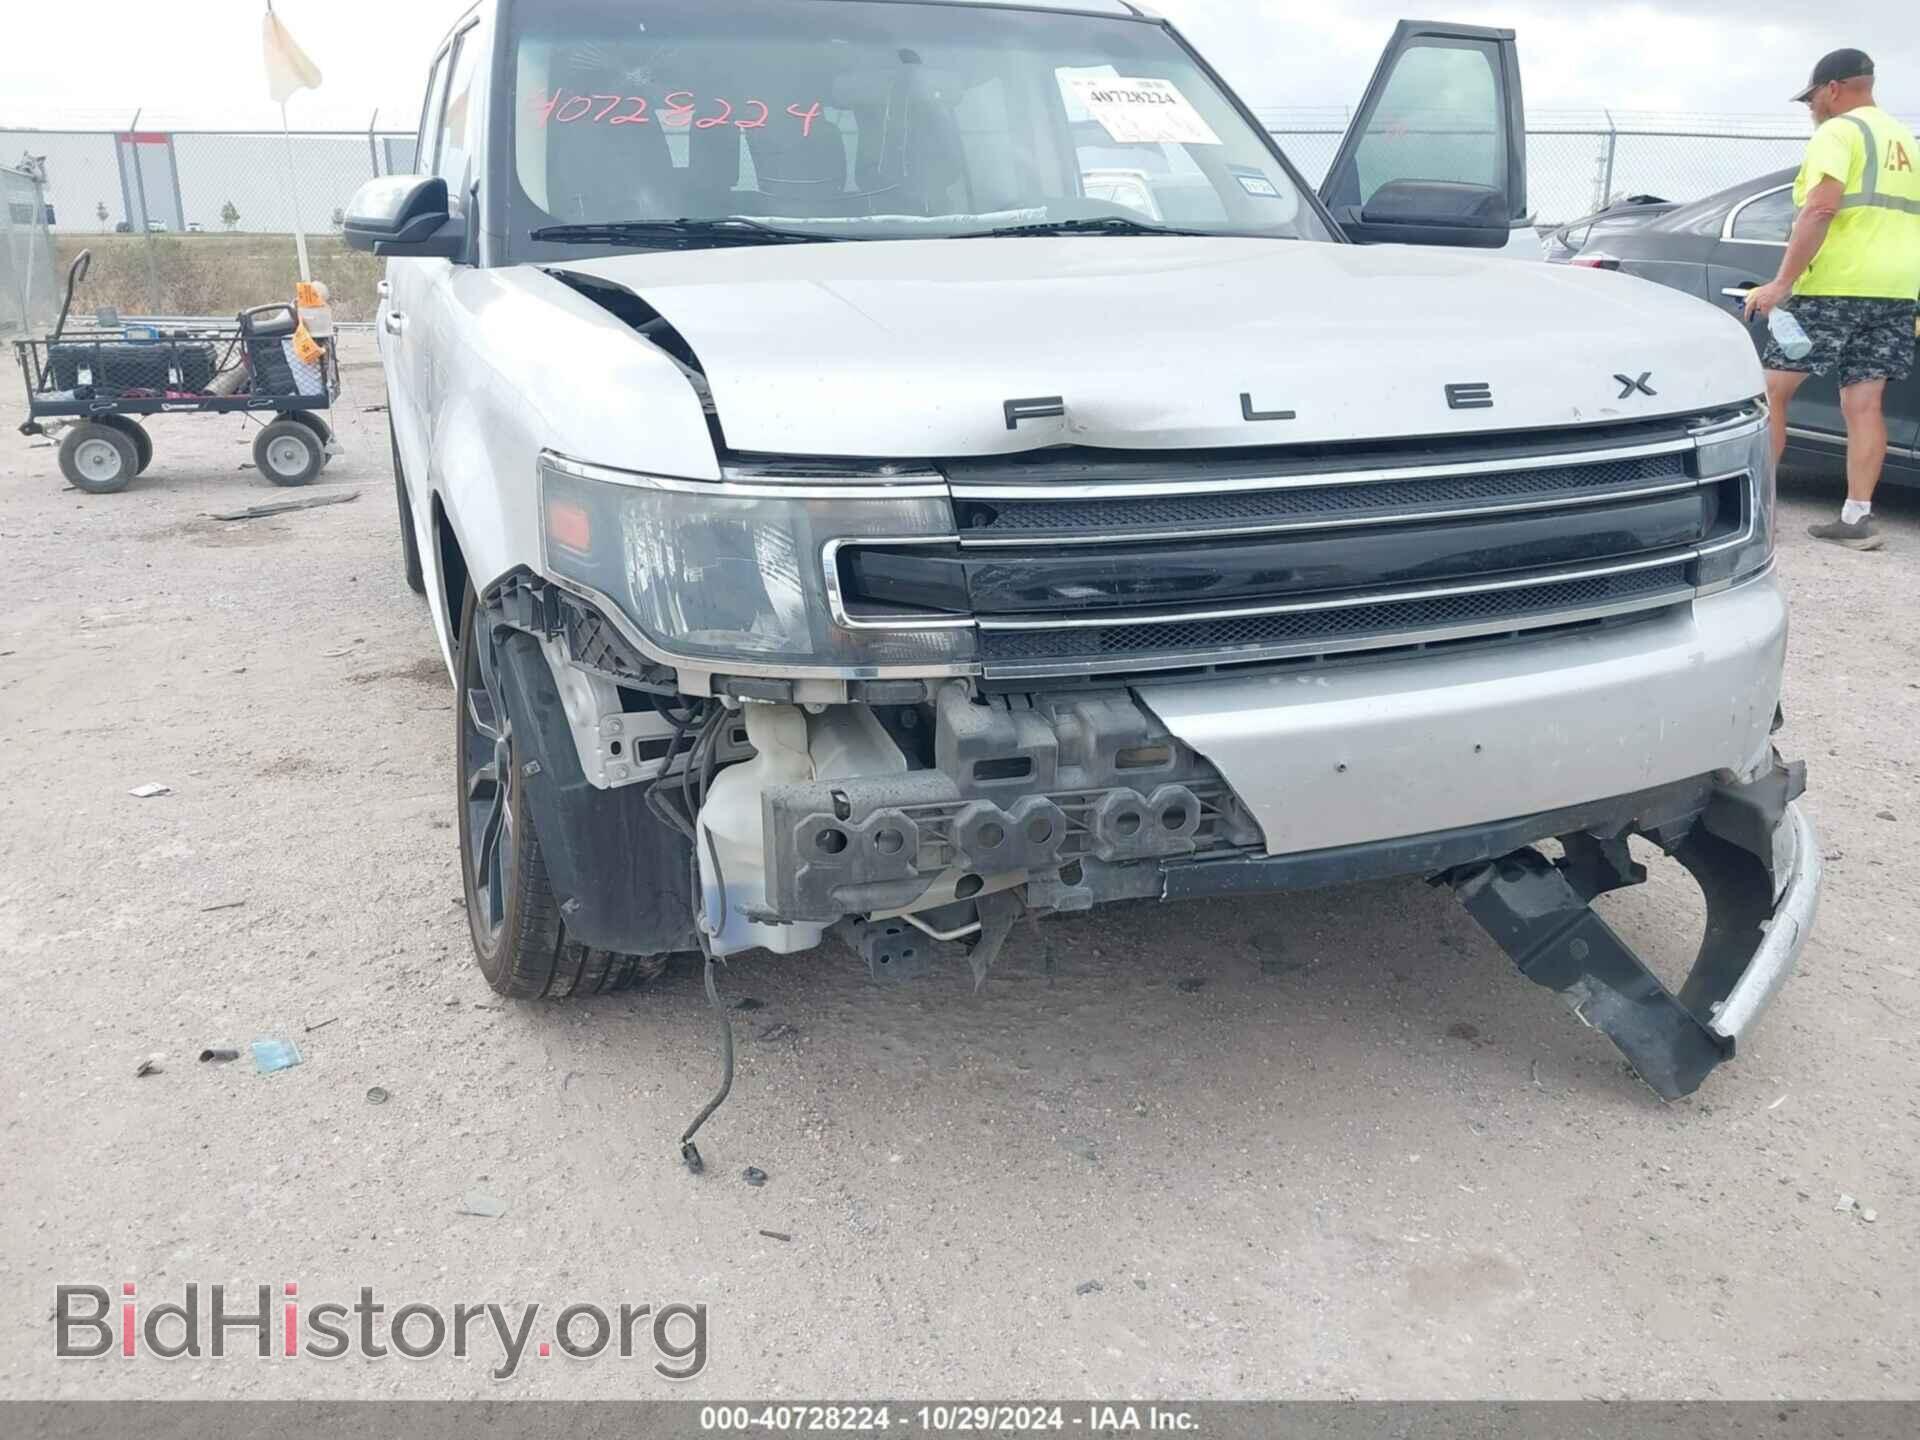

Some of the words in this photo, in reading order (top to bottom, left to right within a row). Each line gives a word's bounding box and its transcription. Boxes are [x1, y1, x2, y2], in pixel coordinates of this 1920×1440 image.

[532, 86, 822, 137] 40728224
[1090, 89, 1177, 105] 40728224
[1003, 370, 1656, 431] FLEX
